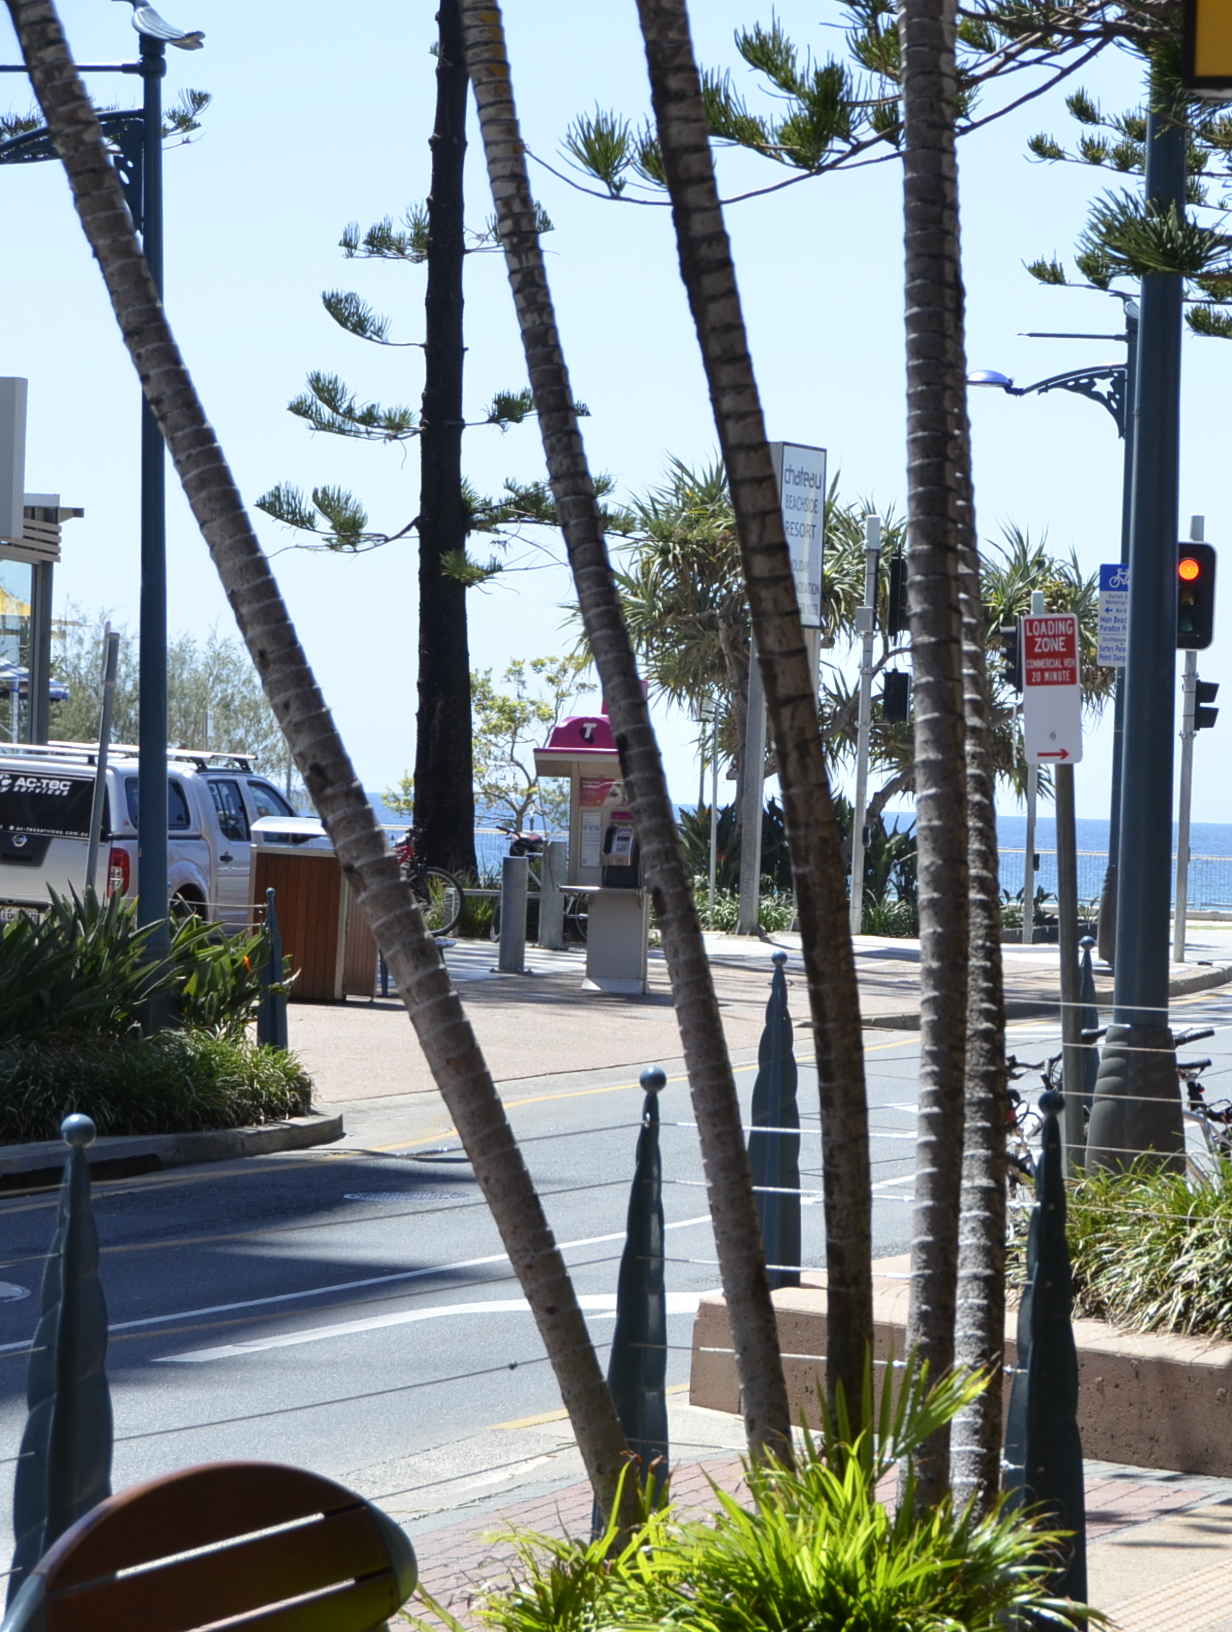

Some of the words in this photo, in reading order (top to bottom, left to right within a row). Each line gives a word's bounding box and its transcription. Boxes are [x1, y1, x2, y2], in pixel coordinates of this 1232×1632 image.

[784, 464, 822, 490] chateau
[785, 494, 819, 514] BEACHSIDE
[785, 520, 817, 539] RESORT
[1100, 616, 1113, 624] Main
[1026, 620, 1073, 636] LOADING
[1100, 624, 1121, 633] Paradise
[1034, 637, 1067, 652] ZONE
[1026, 659, 1062, 669] COMMERCIAL
[1031, 671, 1042, 682] 20
[1044, 670, 1071, 682] MINUTE
[13, 786, 69, 796] services
